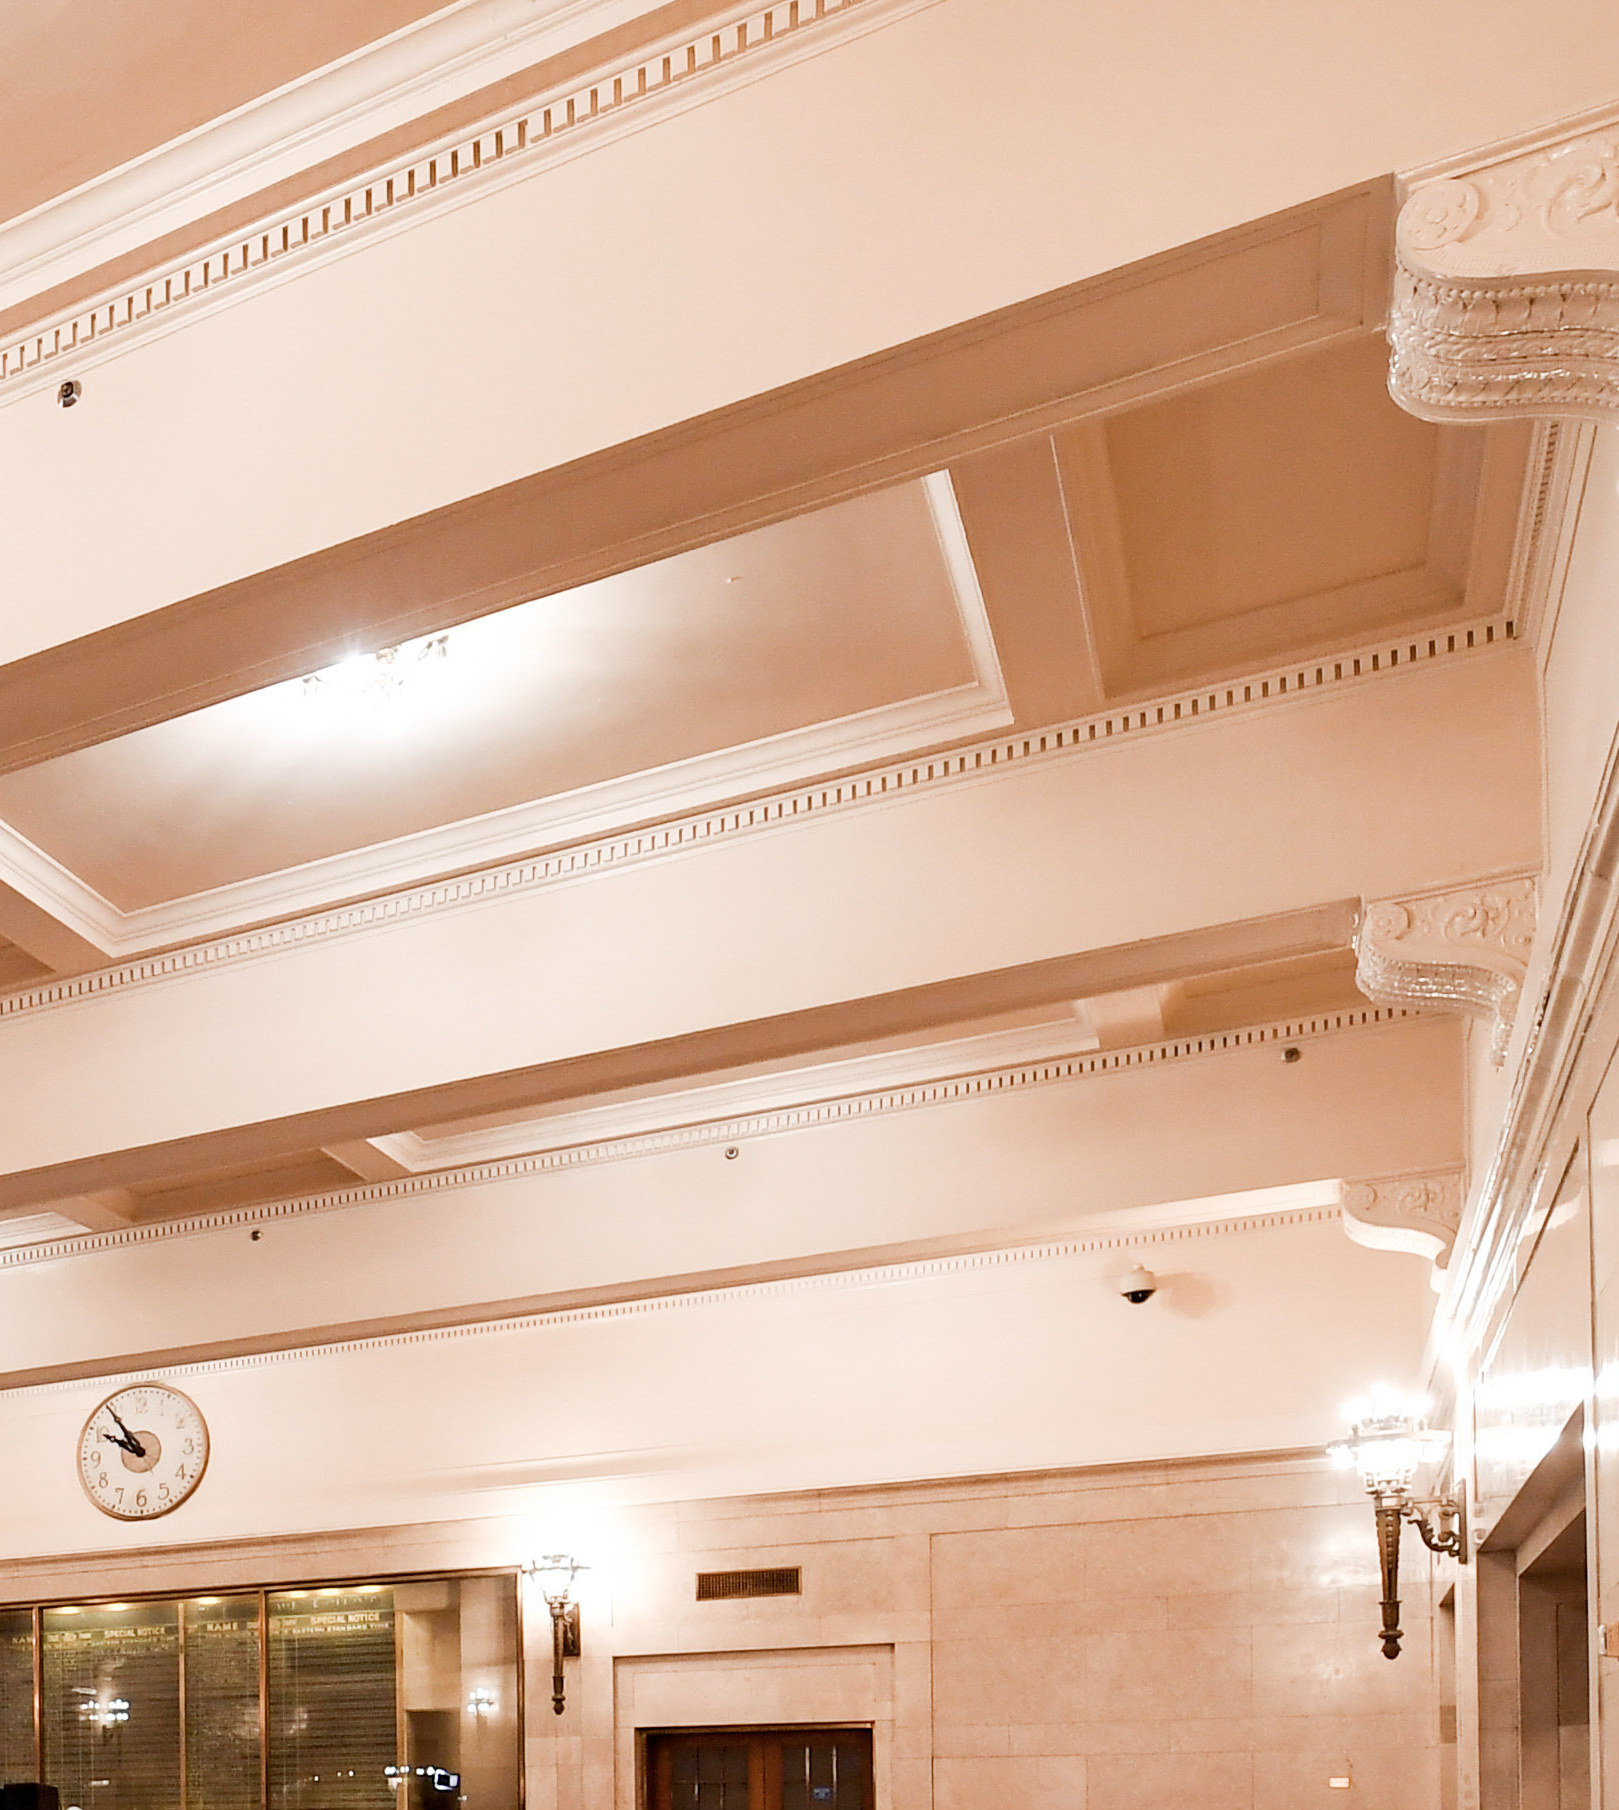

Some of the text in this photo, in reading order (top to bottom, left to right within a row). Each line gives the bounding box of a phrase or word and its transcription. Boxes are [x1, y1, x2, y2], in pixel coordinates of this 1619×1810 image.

[135, 1396, 148, 1415] 12
[159, 1398, 165, 1417] 1
[176, 1412, 186, 1430] 2
[96, 1426, 110, 1444] 10
[182, 1438, 195, 1456] 3
[90, 1451, 102, 1470] 9
[98, 1471, 109, 1489] 8
[175, 1463, 187, 1481] 4
[114, 1487, 125, 1505] 7
[136, 1488, 148, 1508] 6
[158, 1482, 170, 1501] 5
[207, 1621, 239, 1632] NAME
[310, 1613, 346, 1626] SPECIAL
[348, 1611, 380, 1623] NOTICE
[137, 1626, 166, 1637] NOTICE
